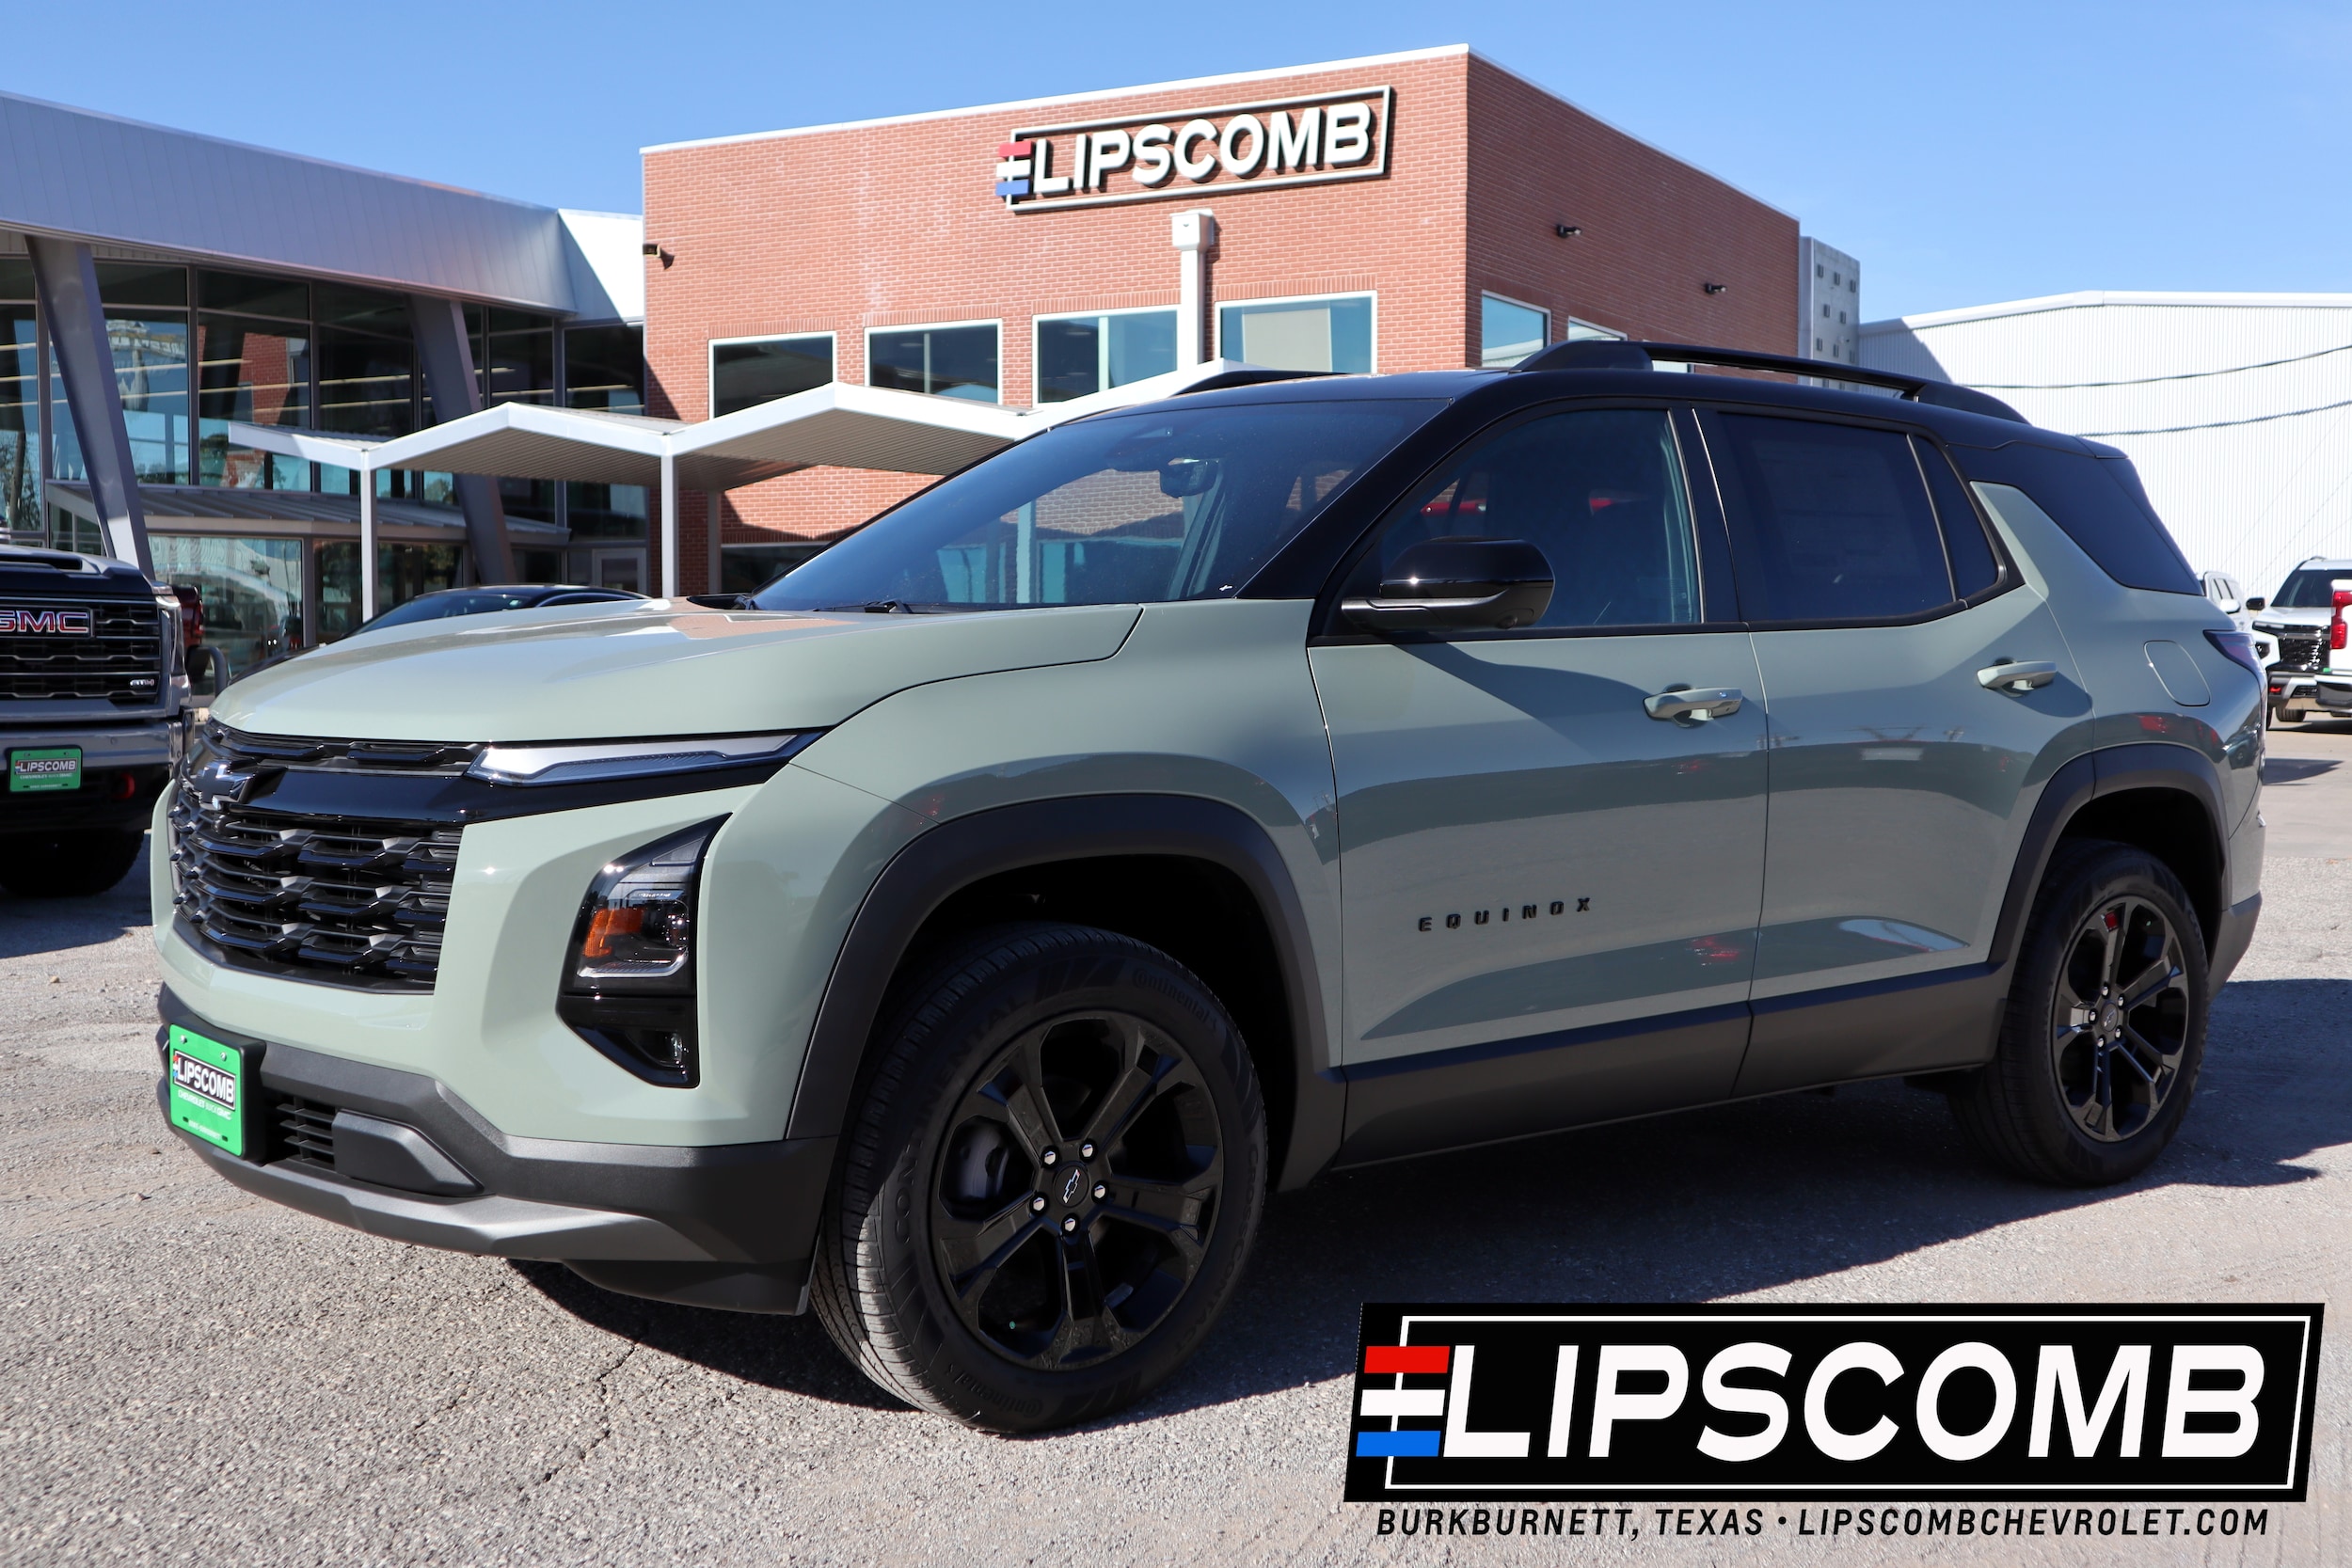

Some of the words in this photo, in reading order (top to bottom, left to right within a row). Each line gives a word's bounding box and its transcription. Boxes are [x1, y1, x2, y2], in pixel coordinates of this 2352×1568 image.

[1033, 101, 1373, 194] LIPSCOMB
[20, 760, 76, 772] LIPSCOMB
[1418, 897, 1590, 932] EQUINOX
[1132, 968, 1211, 1023] Continental
[178, 1055, 234, 1103] LIPSCOMB
